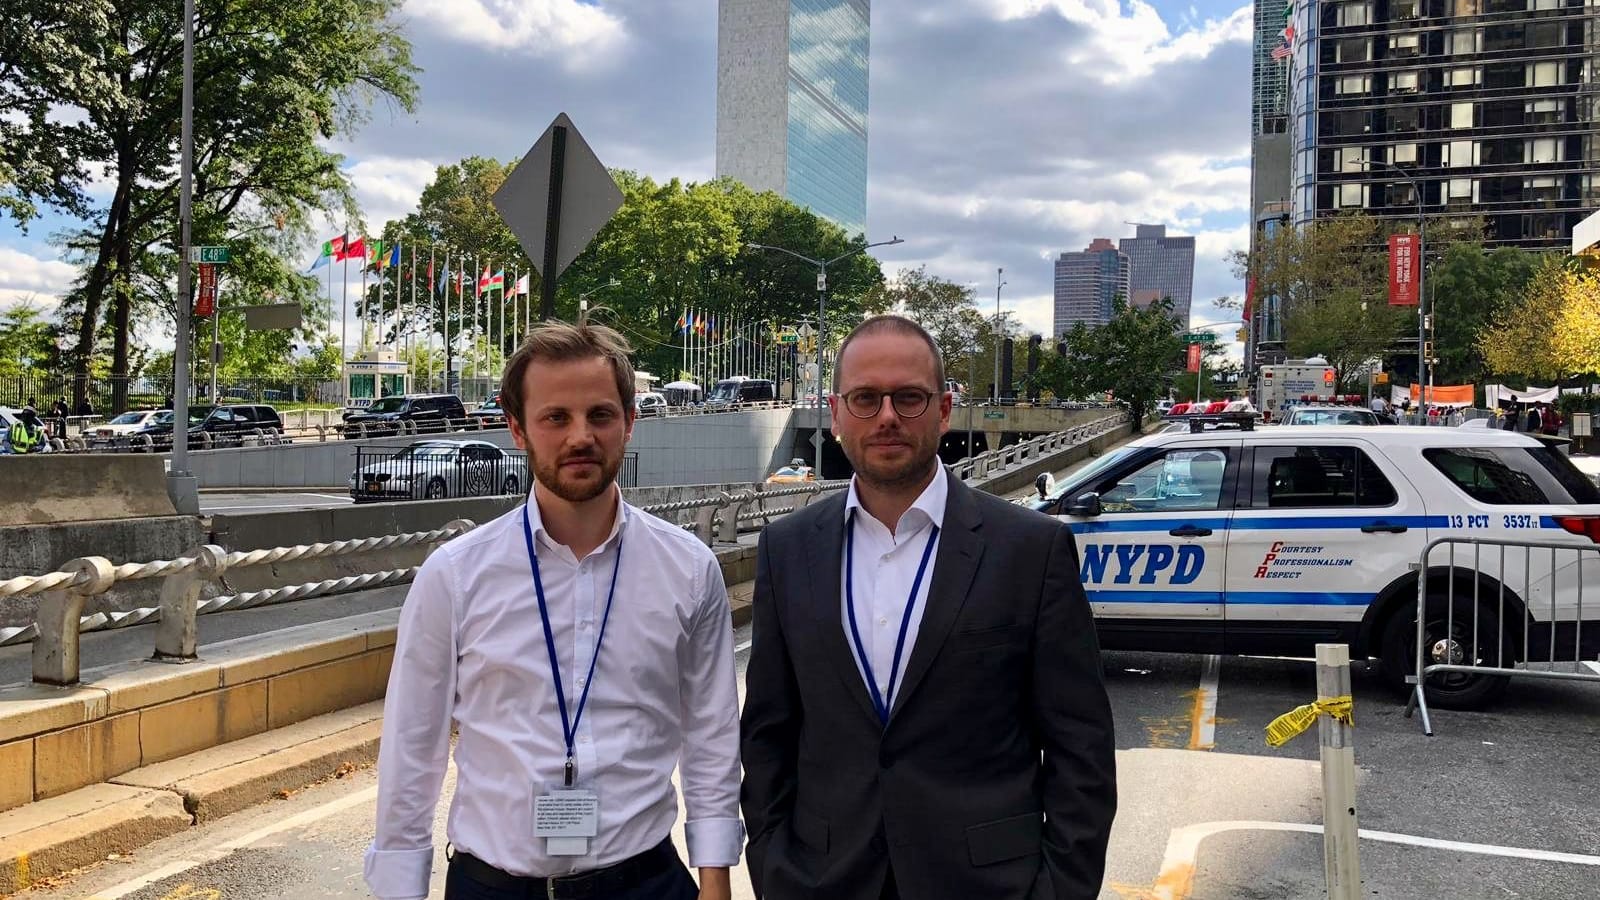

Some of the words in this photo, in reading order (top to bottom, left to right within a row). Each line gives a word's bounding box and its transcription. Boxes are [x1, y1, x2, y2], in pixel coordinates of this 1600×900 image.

[203, 249, 207, 261] E
[208, 249, 218, 261] 48
[1451, 515, 1463, 528] 13
[1467, 515, 1489, 528] PCT
[1270, 541, 1324, 553] COURTESY
[1080, 544, 1206, 585] NYPD
[1262, 553, 1353, 566] PROFESSIONALISM
[1254, 566, 1302, 578] RESPECT
